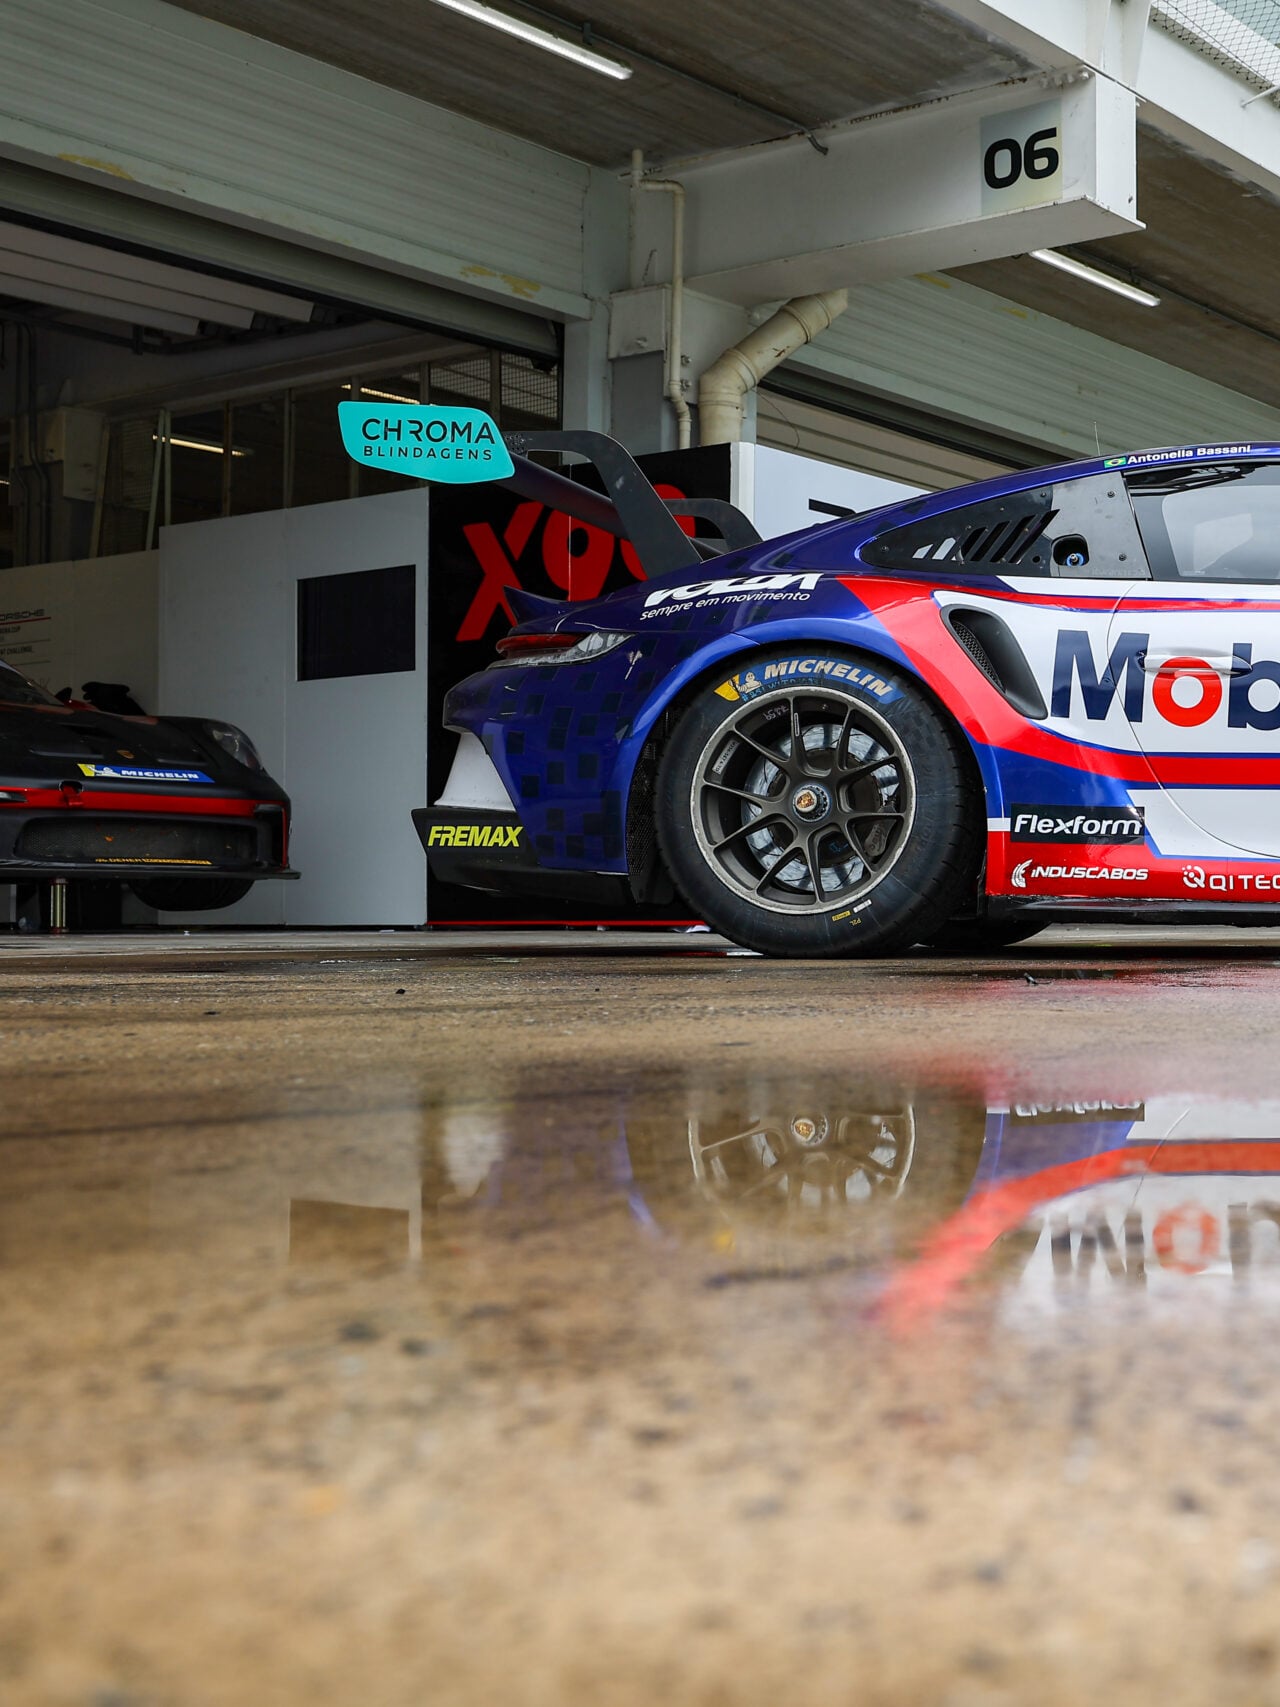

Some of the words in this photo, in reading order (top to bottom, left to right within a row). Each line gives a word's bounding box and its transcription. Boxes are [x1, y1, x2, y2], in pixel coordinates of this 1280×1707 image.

[984, 127, 1059, 189] 06
[362, 418, 496, 444] CHROMA
[364, 446, 493, 460] BLINDAGENS
[1127, 449, 1193, 465] Antonella
[1197, 445, 1251, 456] Bassani
[640, 602, 693, 620] sempre
[696, 598, 719, 608] em
[721, 592, 811, 604] movimento
[764, 659, 892, 697] MICHELIN
[121, 770, 199, 779] MICHELIN
[1014, 815, 1142, 835] Flexform
[428, 826, 523, 847] FREMAX
